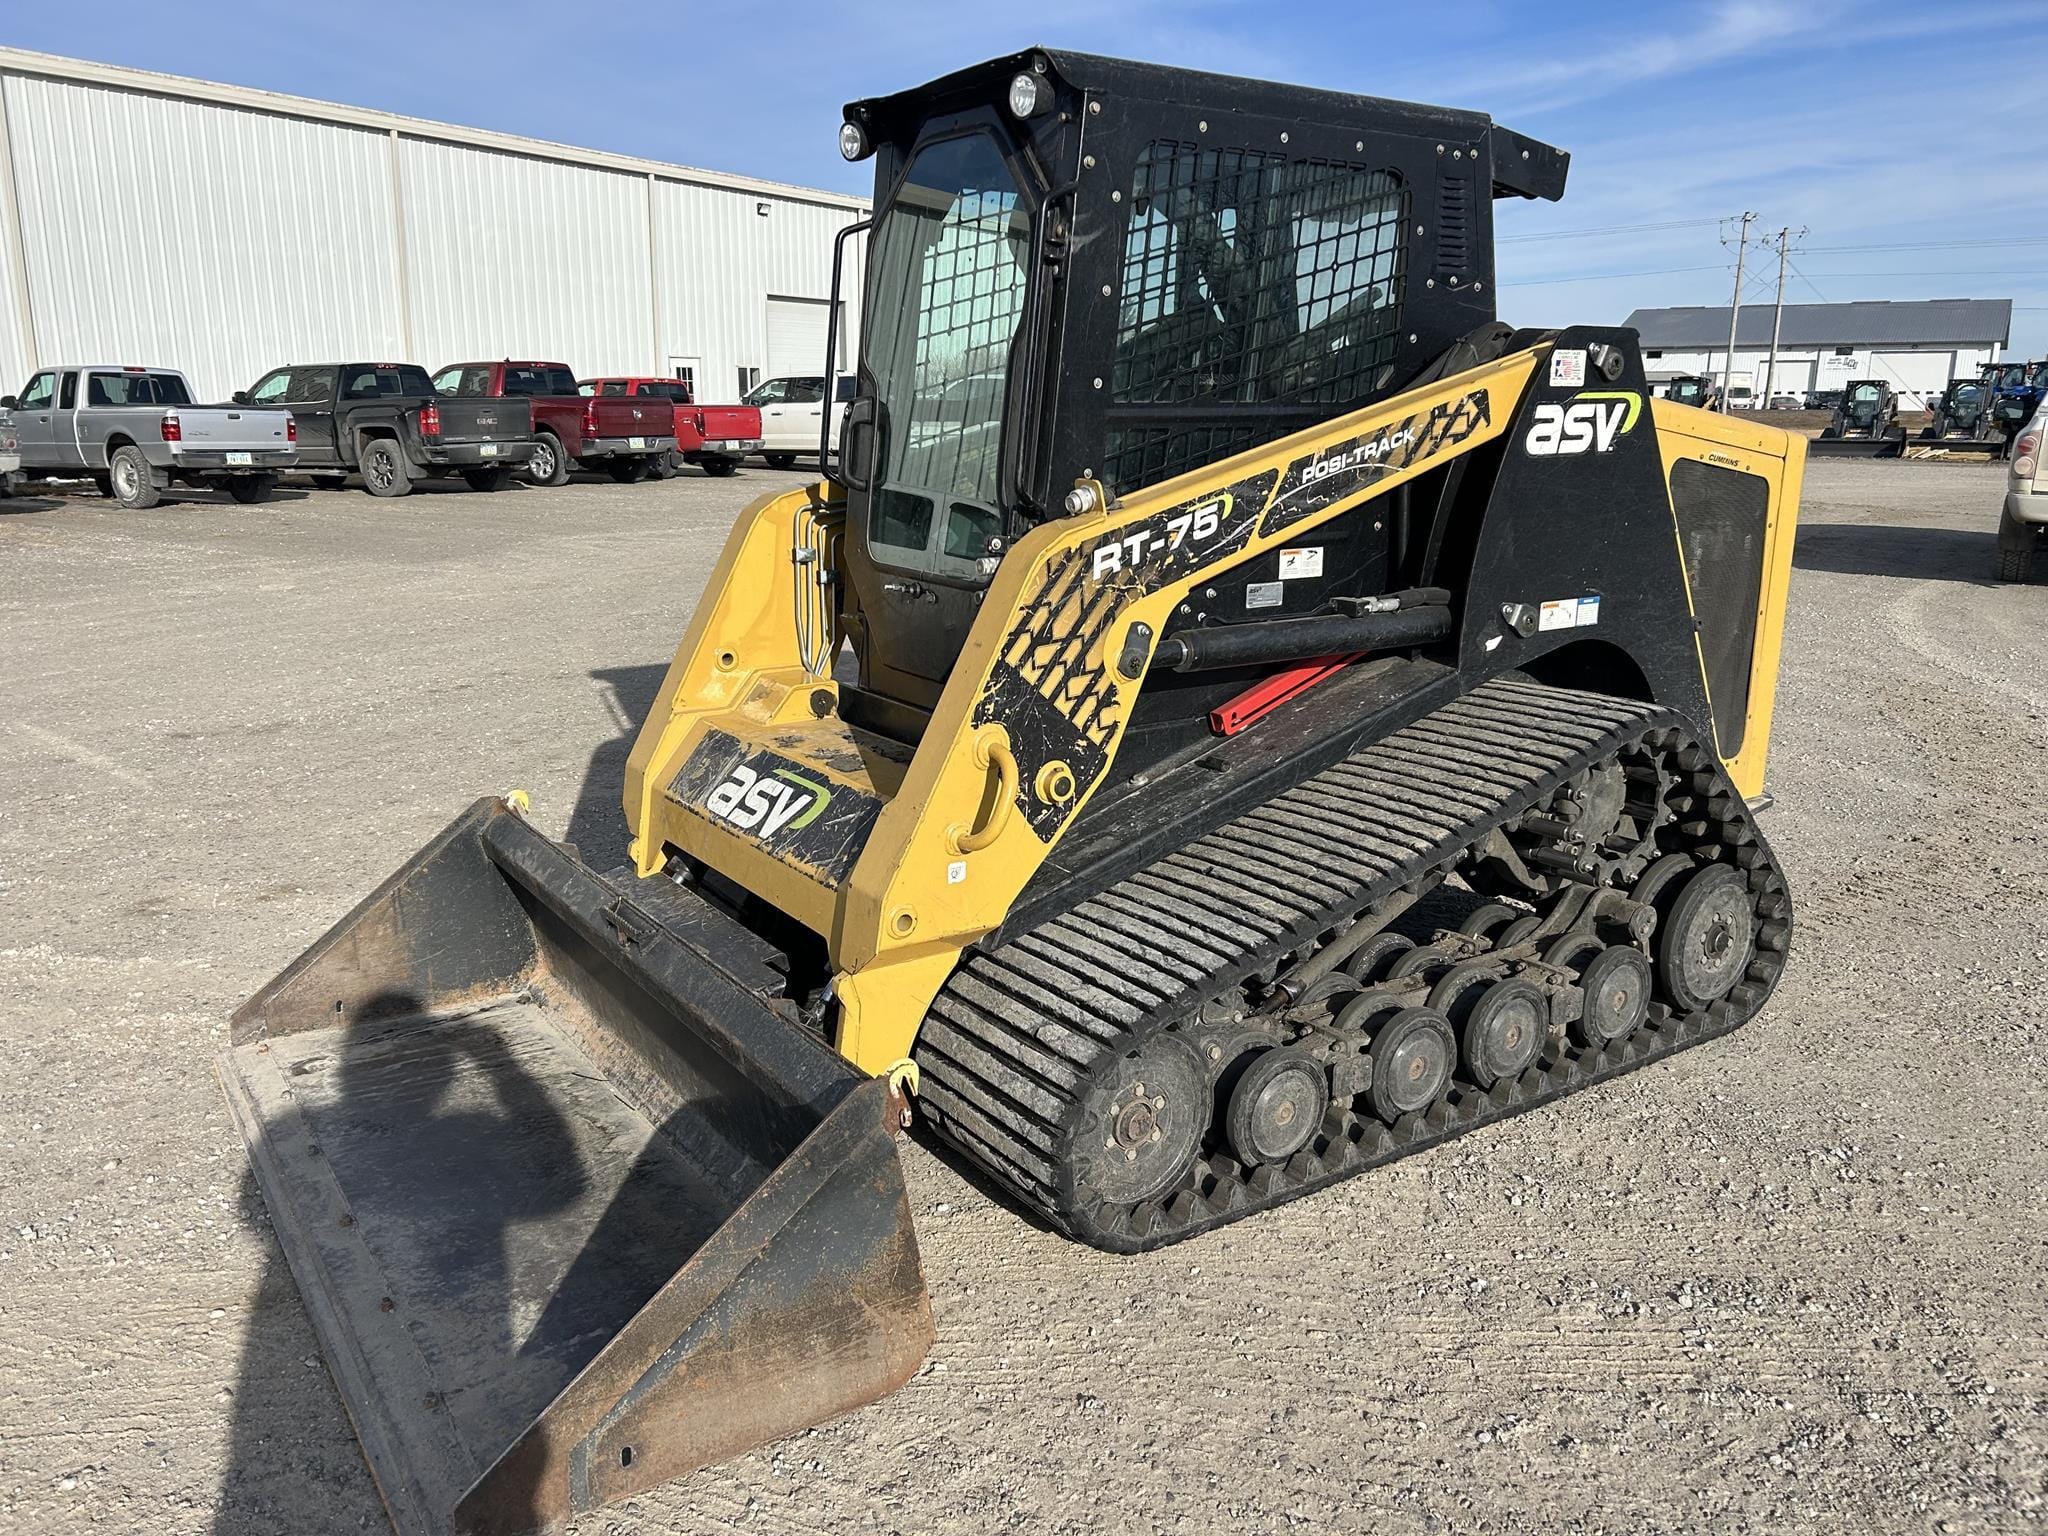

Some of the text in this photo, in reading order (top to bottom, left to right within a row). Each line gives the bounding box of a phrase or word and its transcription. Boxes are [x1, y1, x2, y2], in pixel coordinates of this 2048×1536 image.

[476, 417, 499, 425] GMC
[1302, 427, 1415, 484] POSI-TRACK
[1708, 453, 1740, 467] CUMMINS
[1093, 503, 1218, 581] RT-75
